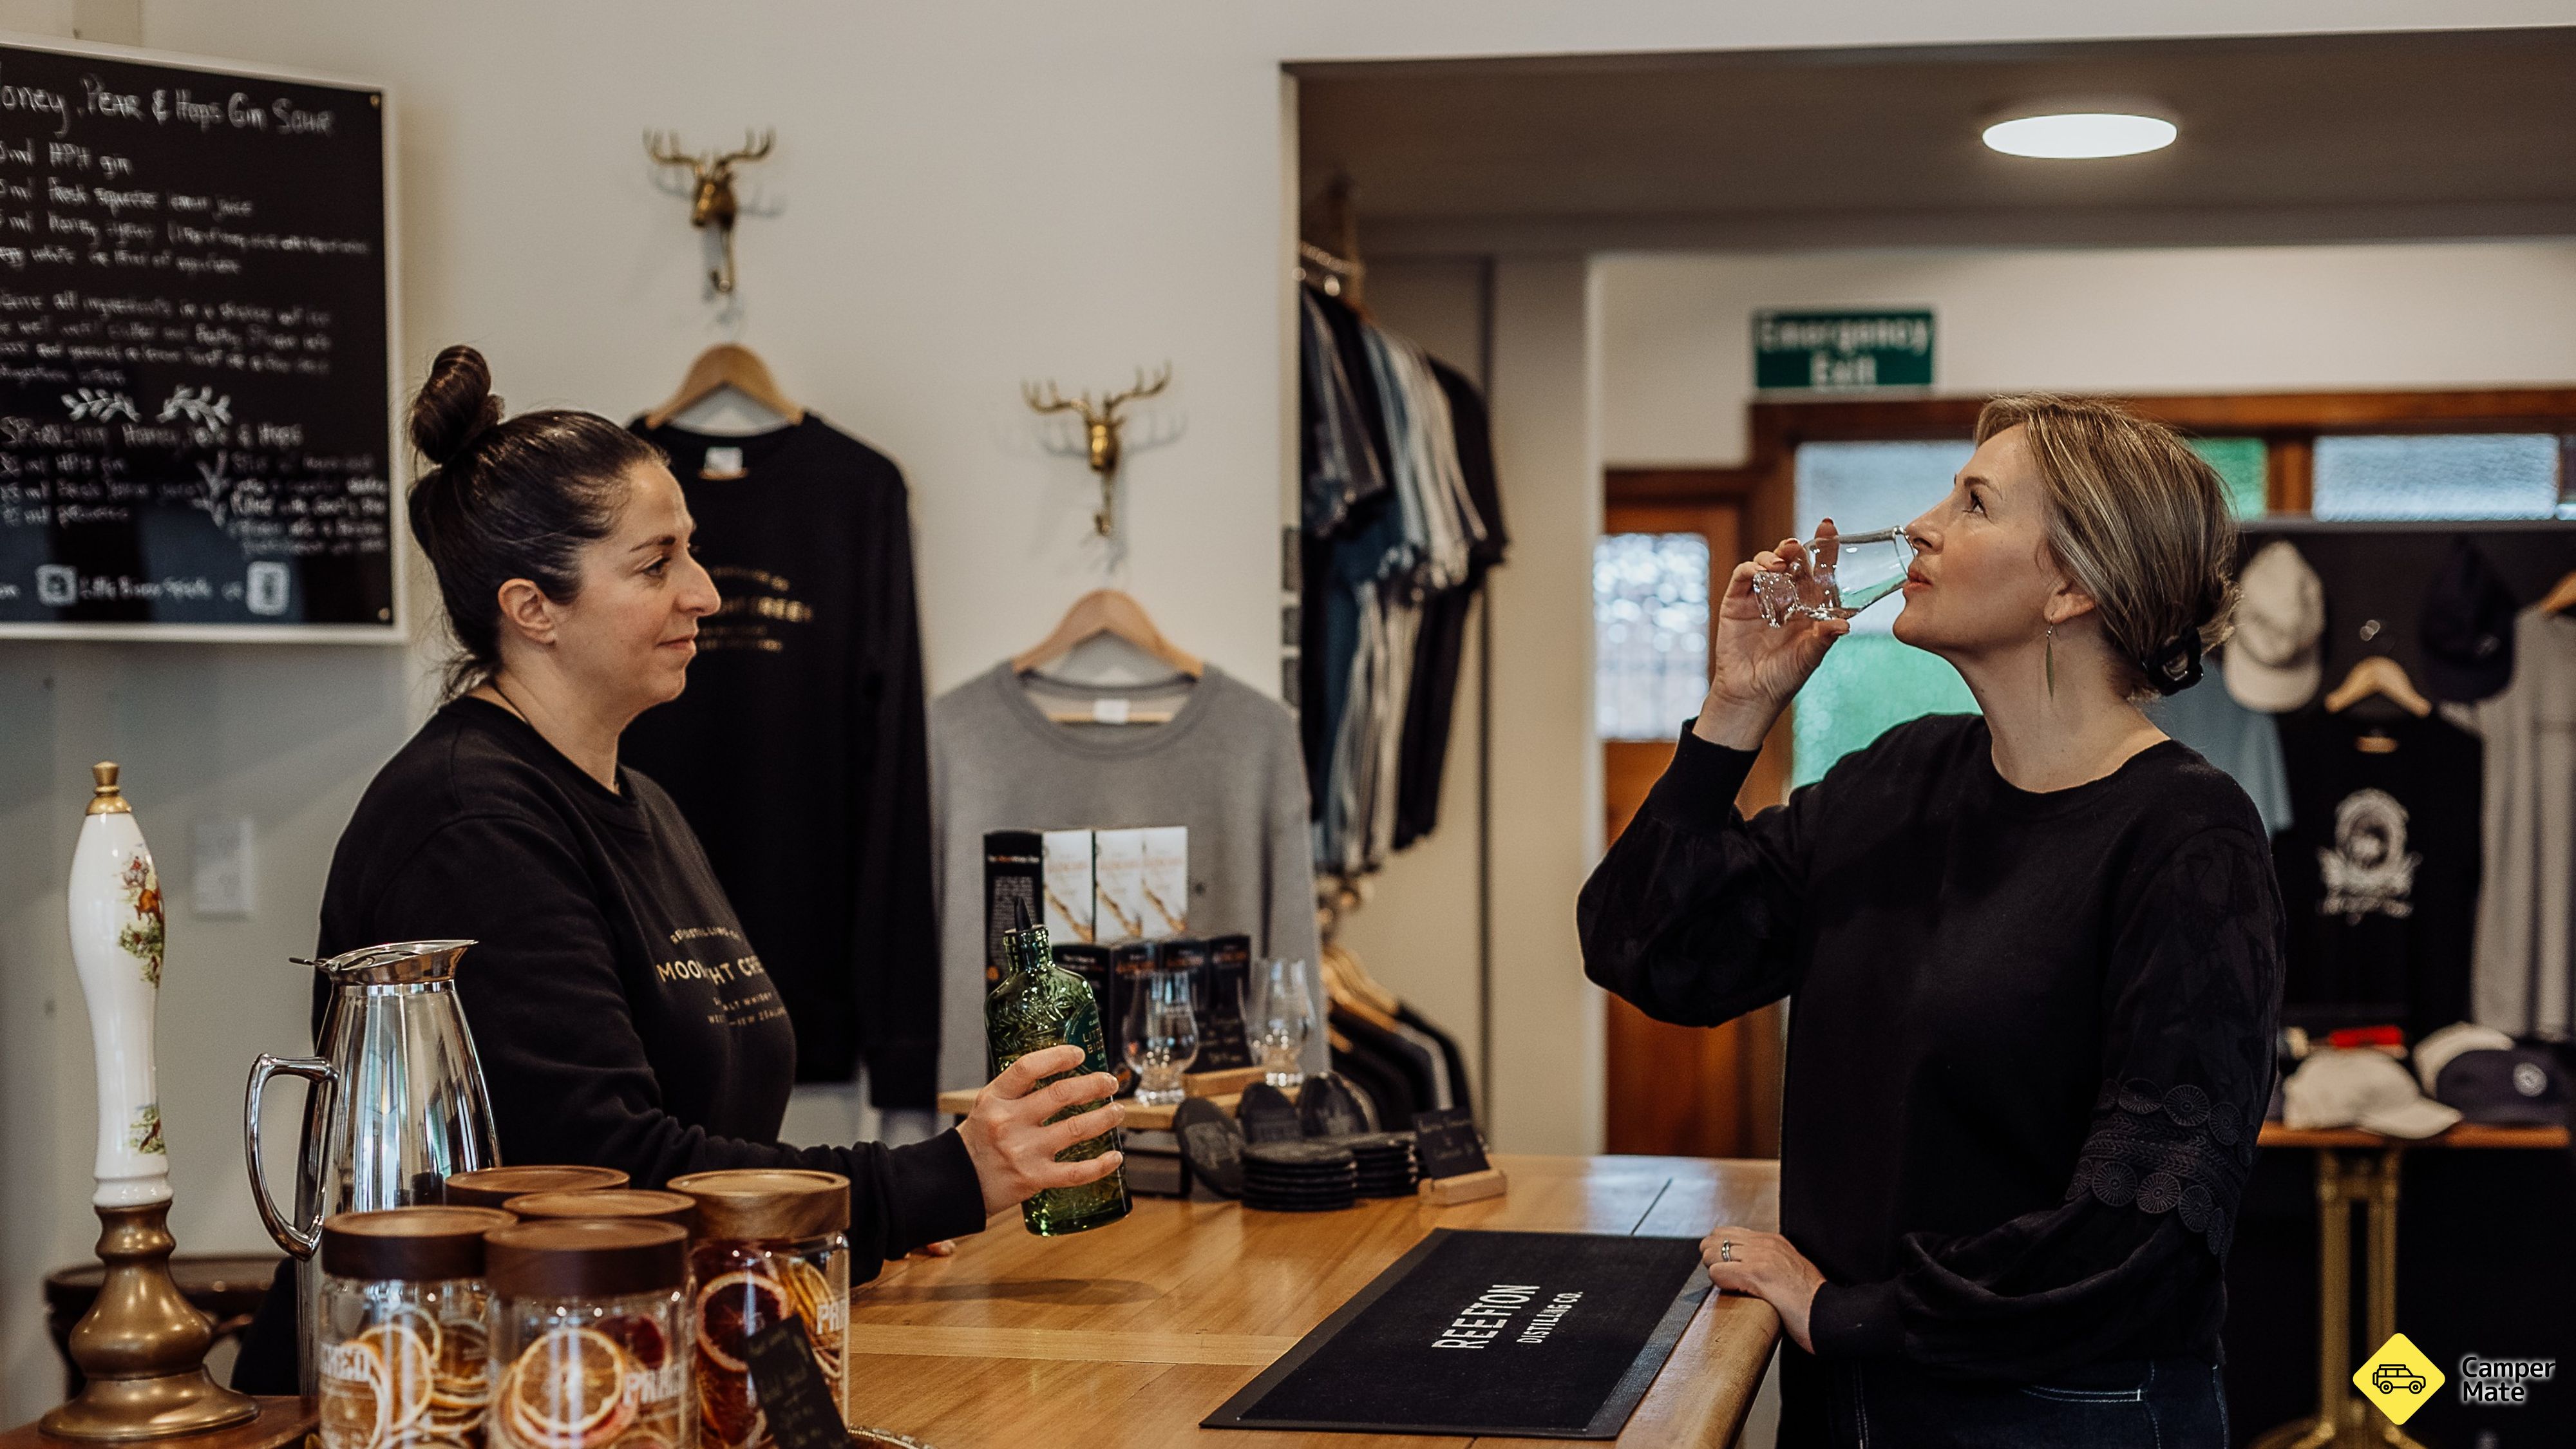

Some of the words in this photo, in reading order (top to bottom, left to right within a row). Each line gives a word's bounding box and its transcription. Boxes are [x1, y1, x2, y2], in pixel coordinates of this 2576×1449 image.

[1759, 316, 1929, 357] Emergency
[1431, 1283, 1540, 1349] REEFTON
[1516, 1303, 1573, 1344] DISTILLING
